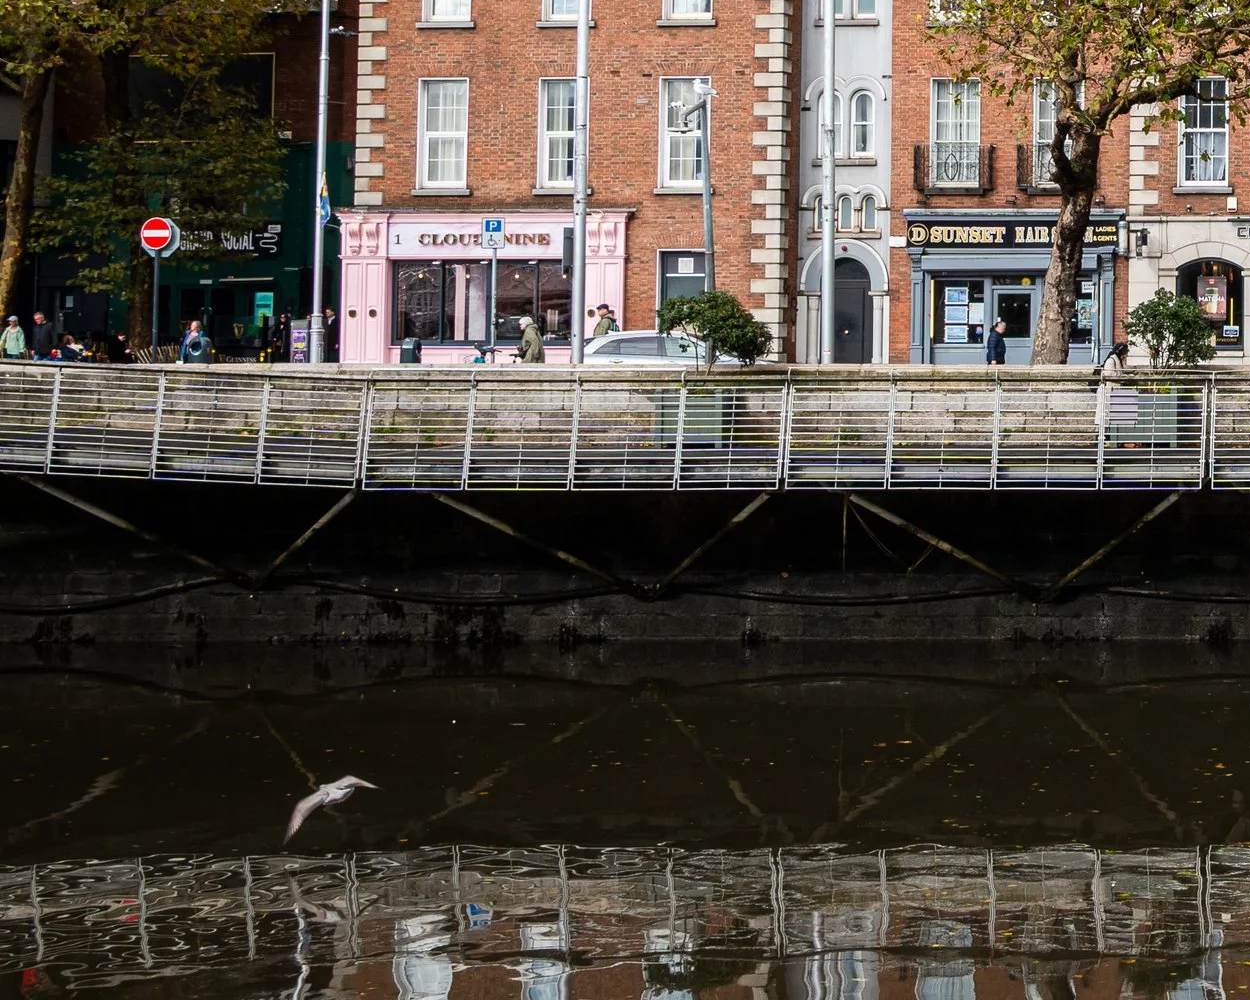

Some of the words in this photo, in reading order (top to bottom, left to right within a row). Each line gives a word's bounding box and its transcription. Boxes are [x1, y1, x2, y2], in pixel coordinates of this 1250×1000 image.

[489, 221, 497, 231] P
[394, 234, 402, 244] 1
[912, 227, 926, 242] D
[930, 226, 1006, 244] SUNSET
[1015, 227, 1049, 244] HAIR
[226, 355, 257, 363] GUINNESS
